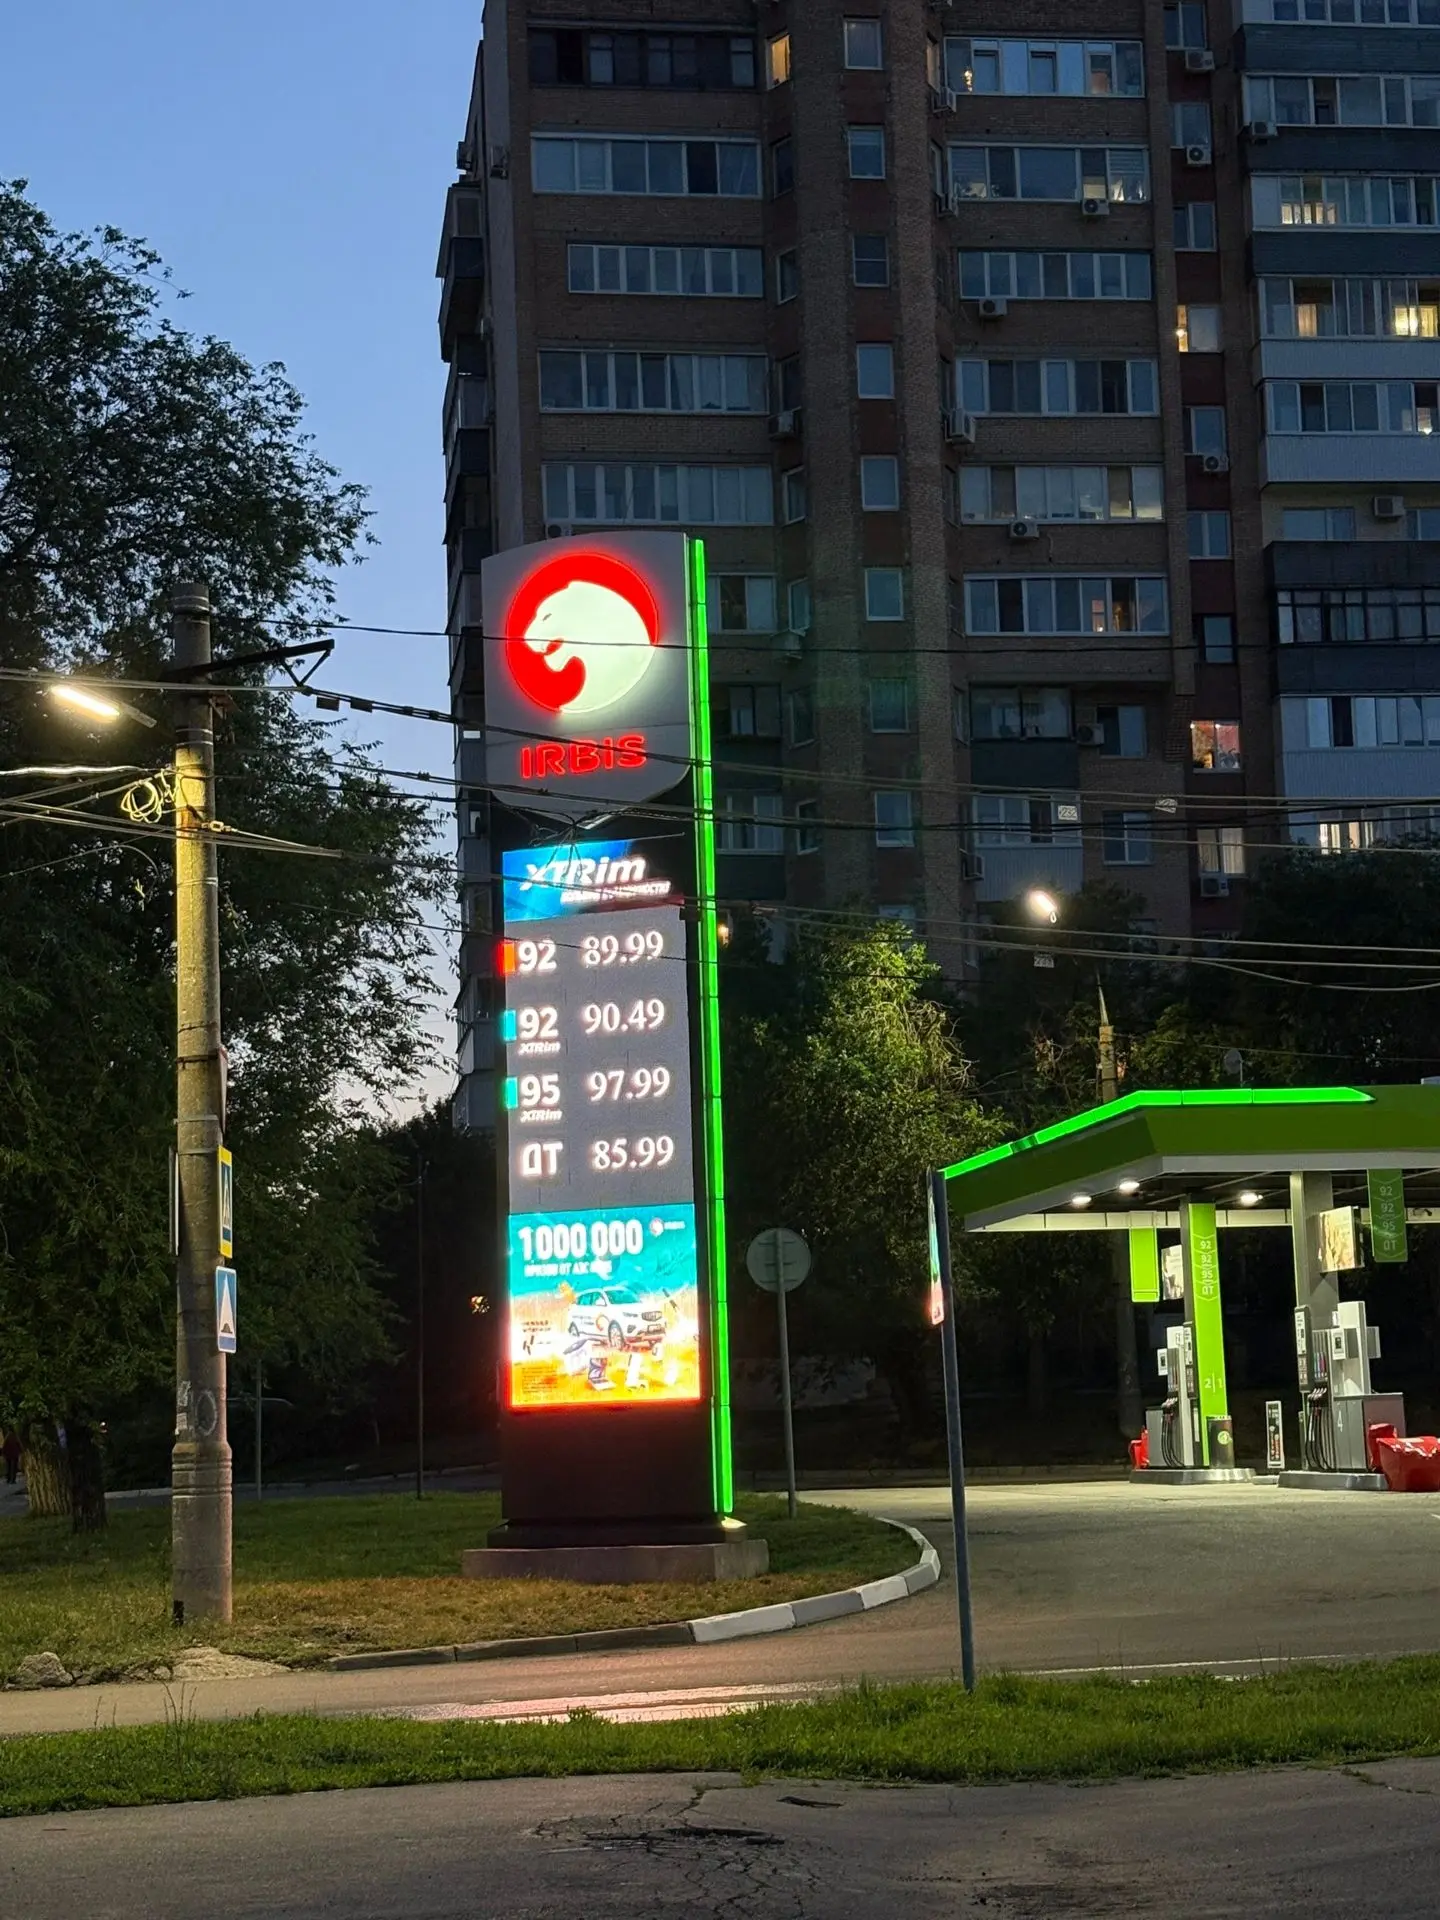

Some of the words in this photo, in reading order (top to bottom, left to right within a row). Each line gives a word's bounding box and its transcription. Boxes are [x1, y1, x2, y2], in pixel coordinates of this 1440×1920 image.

[521, 734, 647, 779] IRBIS
[518, 938, 557, 972] 92
[583, 930, 664, 967] 89.99
[519, 1006, 559, 1040] 92
[584, 998, 665, 1035] 90.49
[520, 1073, 561, 1107] 95
[588, 1066, 671, 1102] 97.99
[521, 1141, 564, 1177] ДТ
[592, 1135, 675, 1171] 85.99
[1380, 1187, 1393, 1196] 92
[1381, 1203, 1394, 1213] 92
[1383, 1221, 1396, 1231] 95
[518, 1226, 533, 1261] 1
[535, 1222, 587, 1261] 000
[591, 1219, 643, 1257] 000
[1200, 1240, 1212, 1250] 92
[1201, 1254, 1212, 1264] 92
[1202, 1270, 1213, 1280] 95
[1204, 1378, 1212, 1389] 2
[1217, 1378, 1224, 1389] 1
